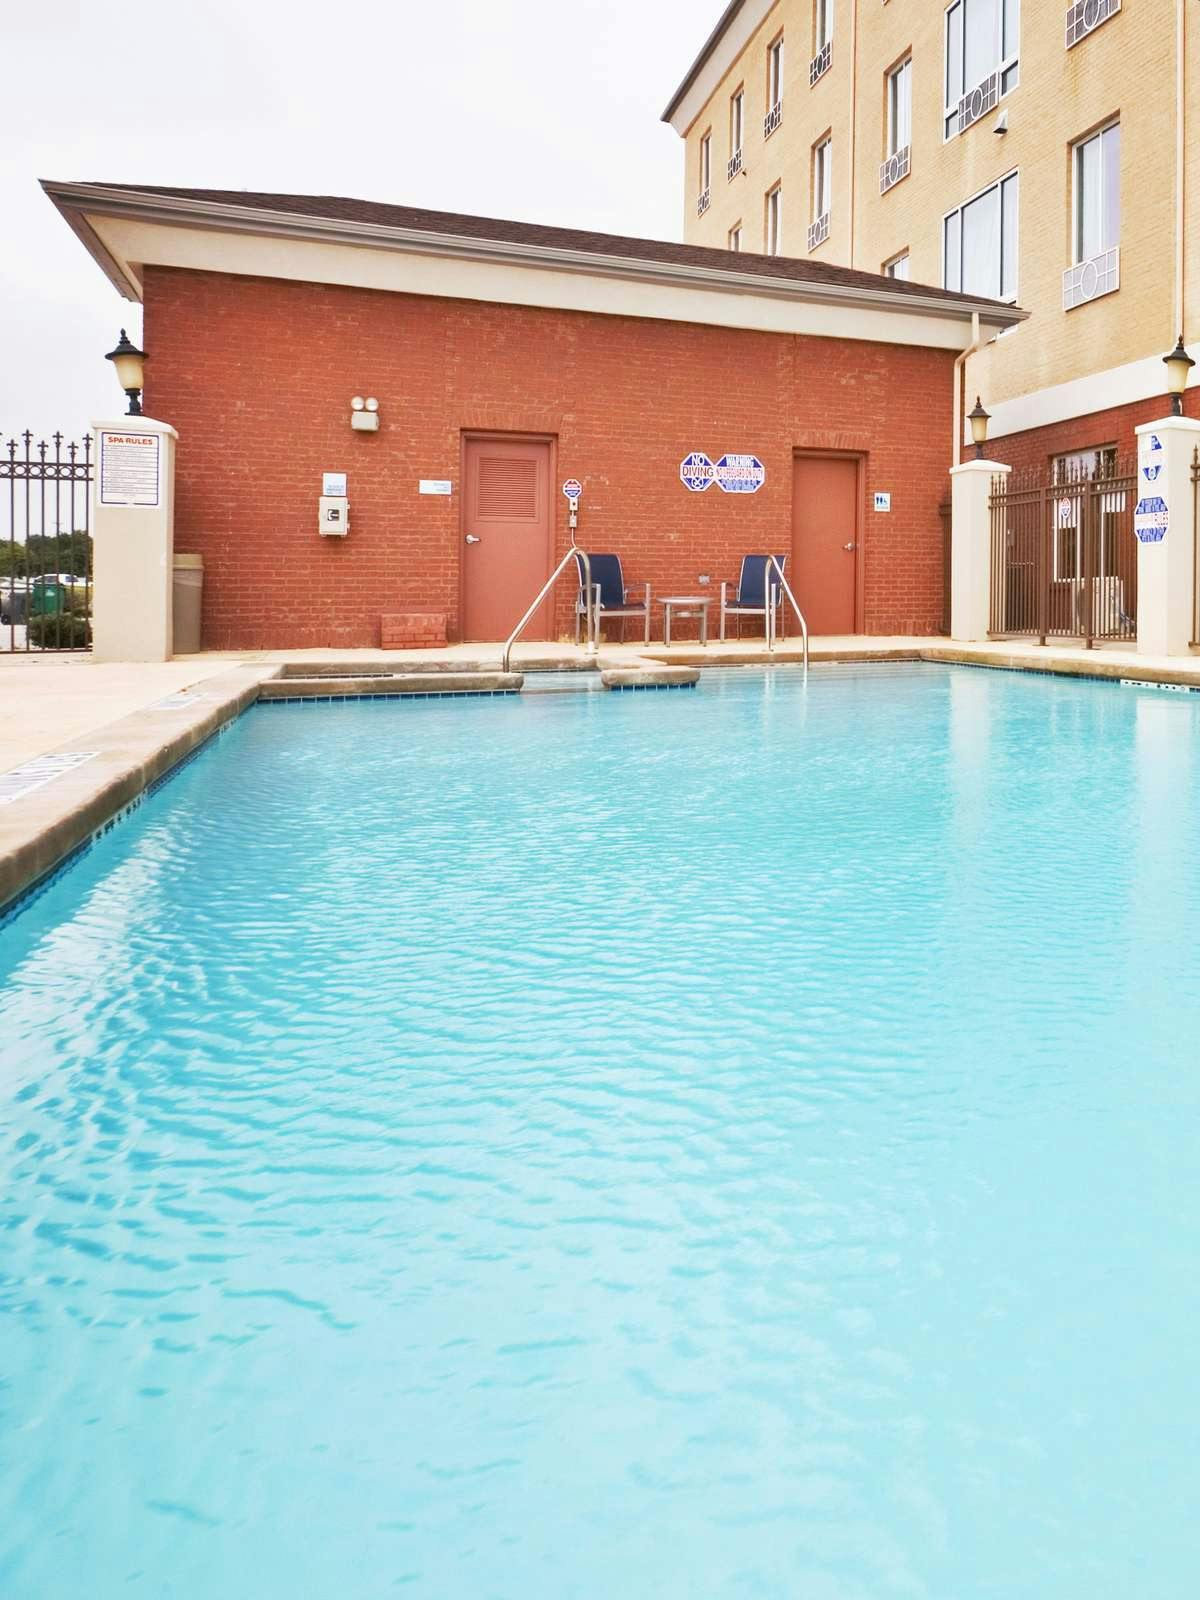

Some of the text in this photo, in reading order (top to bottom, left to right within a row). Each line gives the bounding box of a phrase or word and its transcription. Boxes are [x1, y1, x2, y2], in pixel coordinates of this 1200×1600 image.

[126, 437, 153, 445] RULES
[692, 454, 704, 466] NO
[726, 456, 754, 467] WARNING
[682, 466, 714, 477] DIVING
